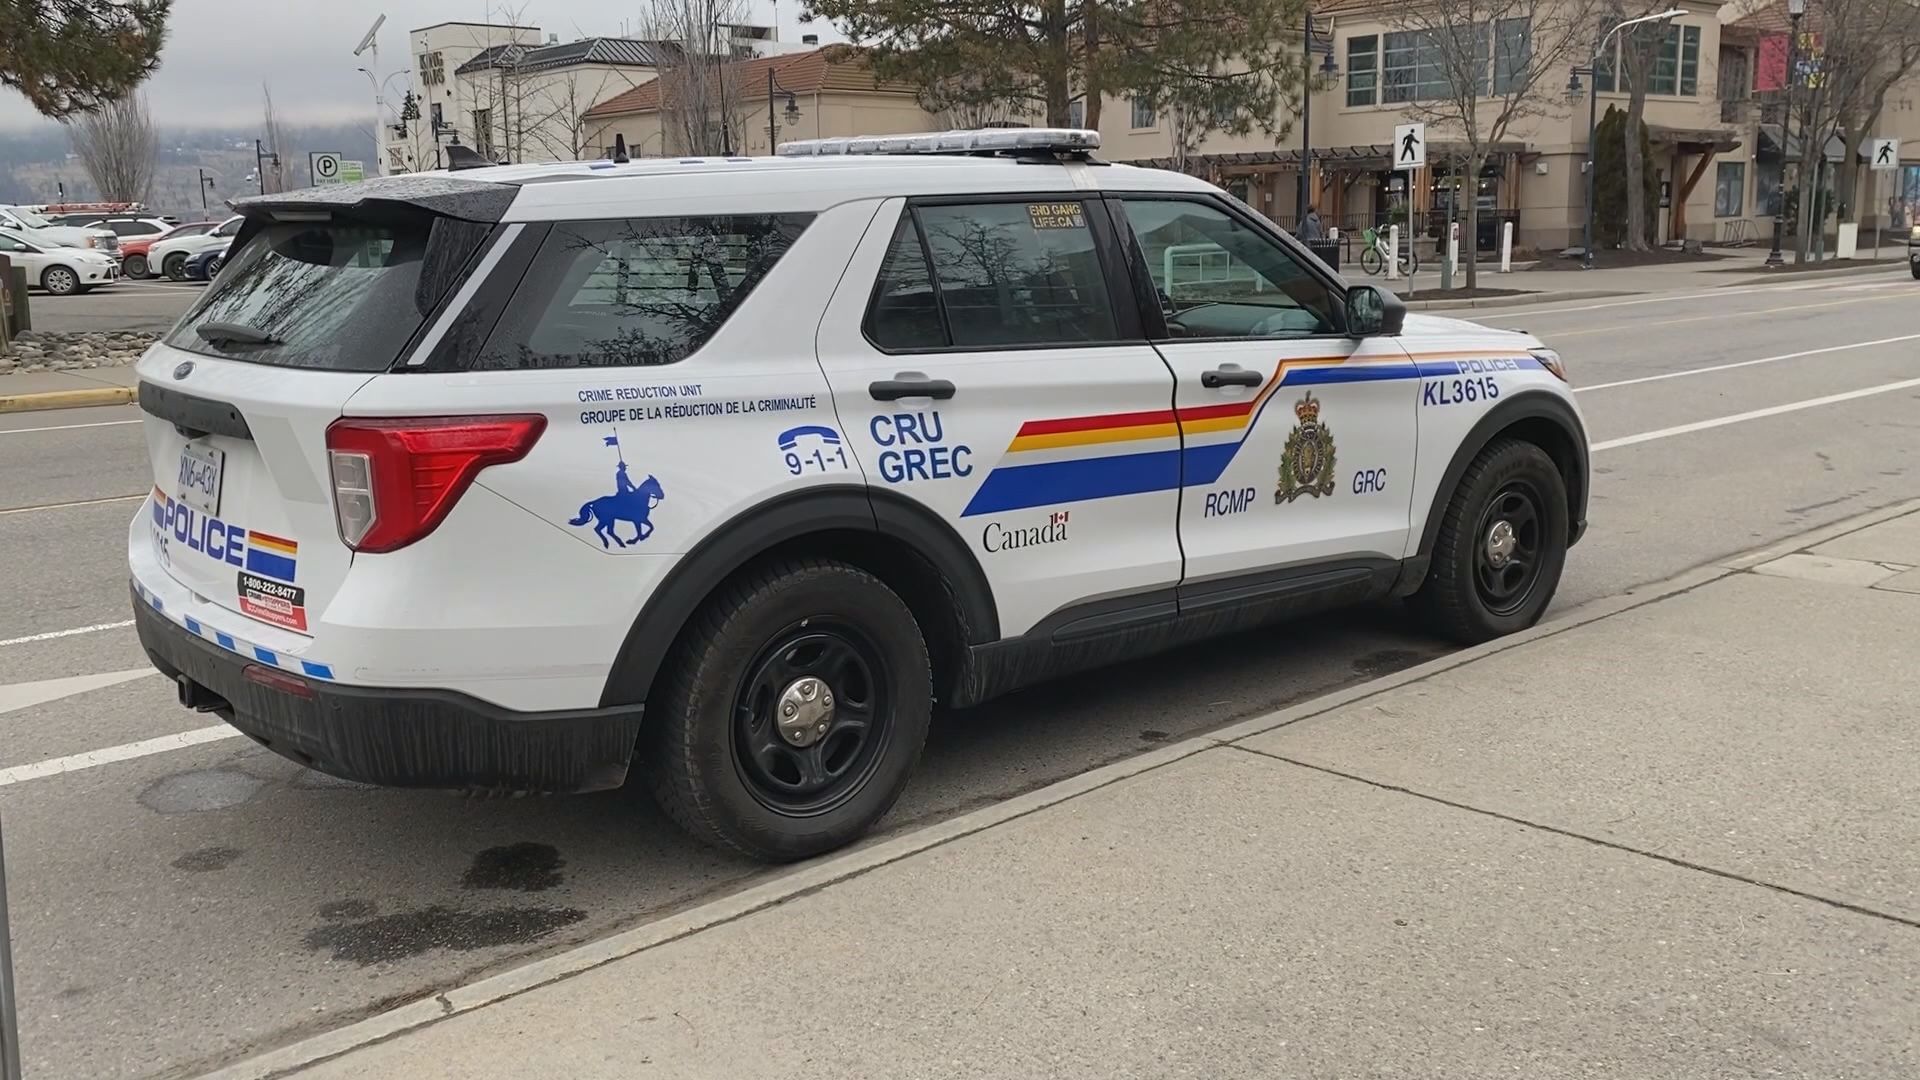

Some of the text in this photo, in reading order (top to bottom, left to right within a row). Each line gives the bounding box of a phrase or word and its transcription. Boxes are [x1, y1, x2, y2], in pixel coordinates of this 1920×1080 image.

[1029, 204, 1080, 216] END GANG
[1032, 216, 1074, 228] LIFE.CA
[1458, 359, 1517, 374] POLICE
[578, 384, 702, 402] CRIME REDUCTION UNIT
[1423, 376, 1499, 406] KL3615
[580, 394, 816, 424] GROUPE DE LA RÉDUCTION DE LA CRIMINALITÉ
[869, 411, 943, 447] CRU
[785, 447, 848, 476] 9-1-1
[878, 445, 973, 483] GREC
[1352, 468, 1386, 494] GRC
[1204, 487, 1255, 518] RCMP
[164, 495, 245, 567] POLICE
[982, 513, 1067, 553] Canada
[243, 576, 297, 600] 1-800-222-8477
